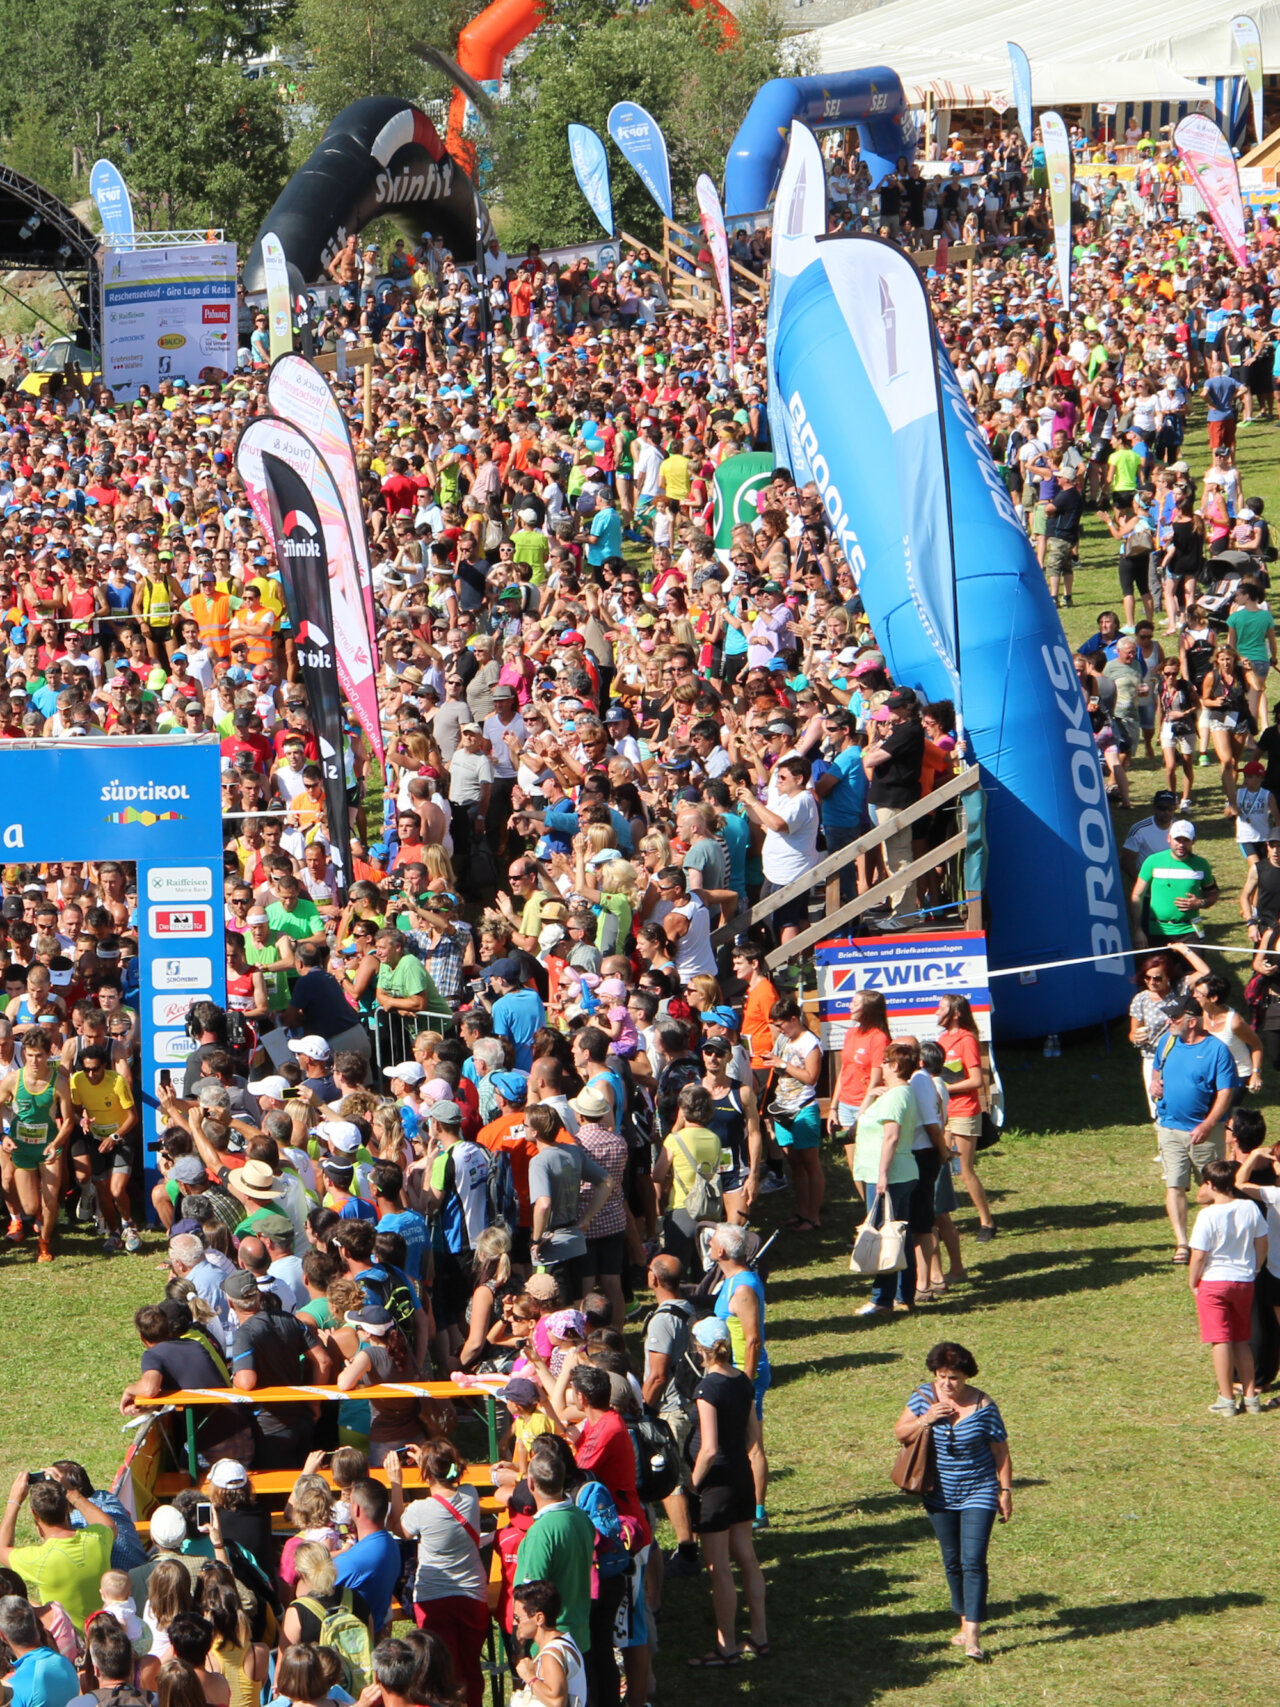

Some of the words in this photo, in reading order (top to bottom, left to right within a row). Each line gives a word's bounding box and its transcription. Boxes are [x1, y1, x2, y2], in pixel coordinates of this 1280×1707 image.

[823, 100, 841, 117] SEL
[870, 94, 888, 112] SEL
[375, 162, 453, 203] skinfit
[109, 288, 161, 301] Reschenseelauf
[167, 287, 182, 297] Giro
[184, 286, 201, 296] Lago
[203, 285, 210, 293] di
[212, 284, 231, 293] Resia
[789, 391, 867, 586] BROOKS
[1040, 640, 1127, 976] BROOKS
[166, 878, 208, 887] Raiffeisen
[880, 948, 893, 956] und
[895, 944, 963, 956] Briefkastenanlagen
[863, 962, 969, 990] ZWICK
[885, 996, 907, 1005] ettere
[172, 1040, 198, 1051] mila
